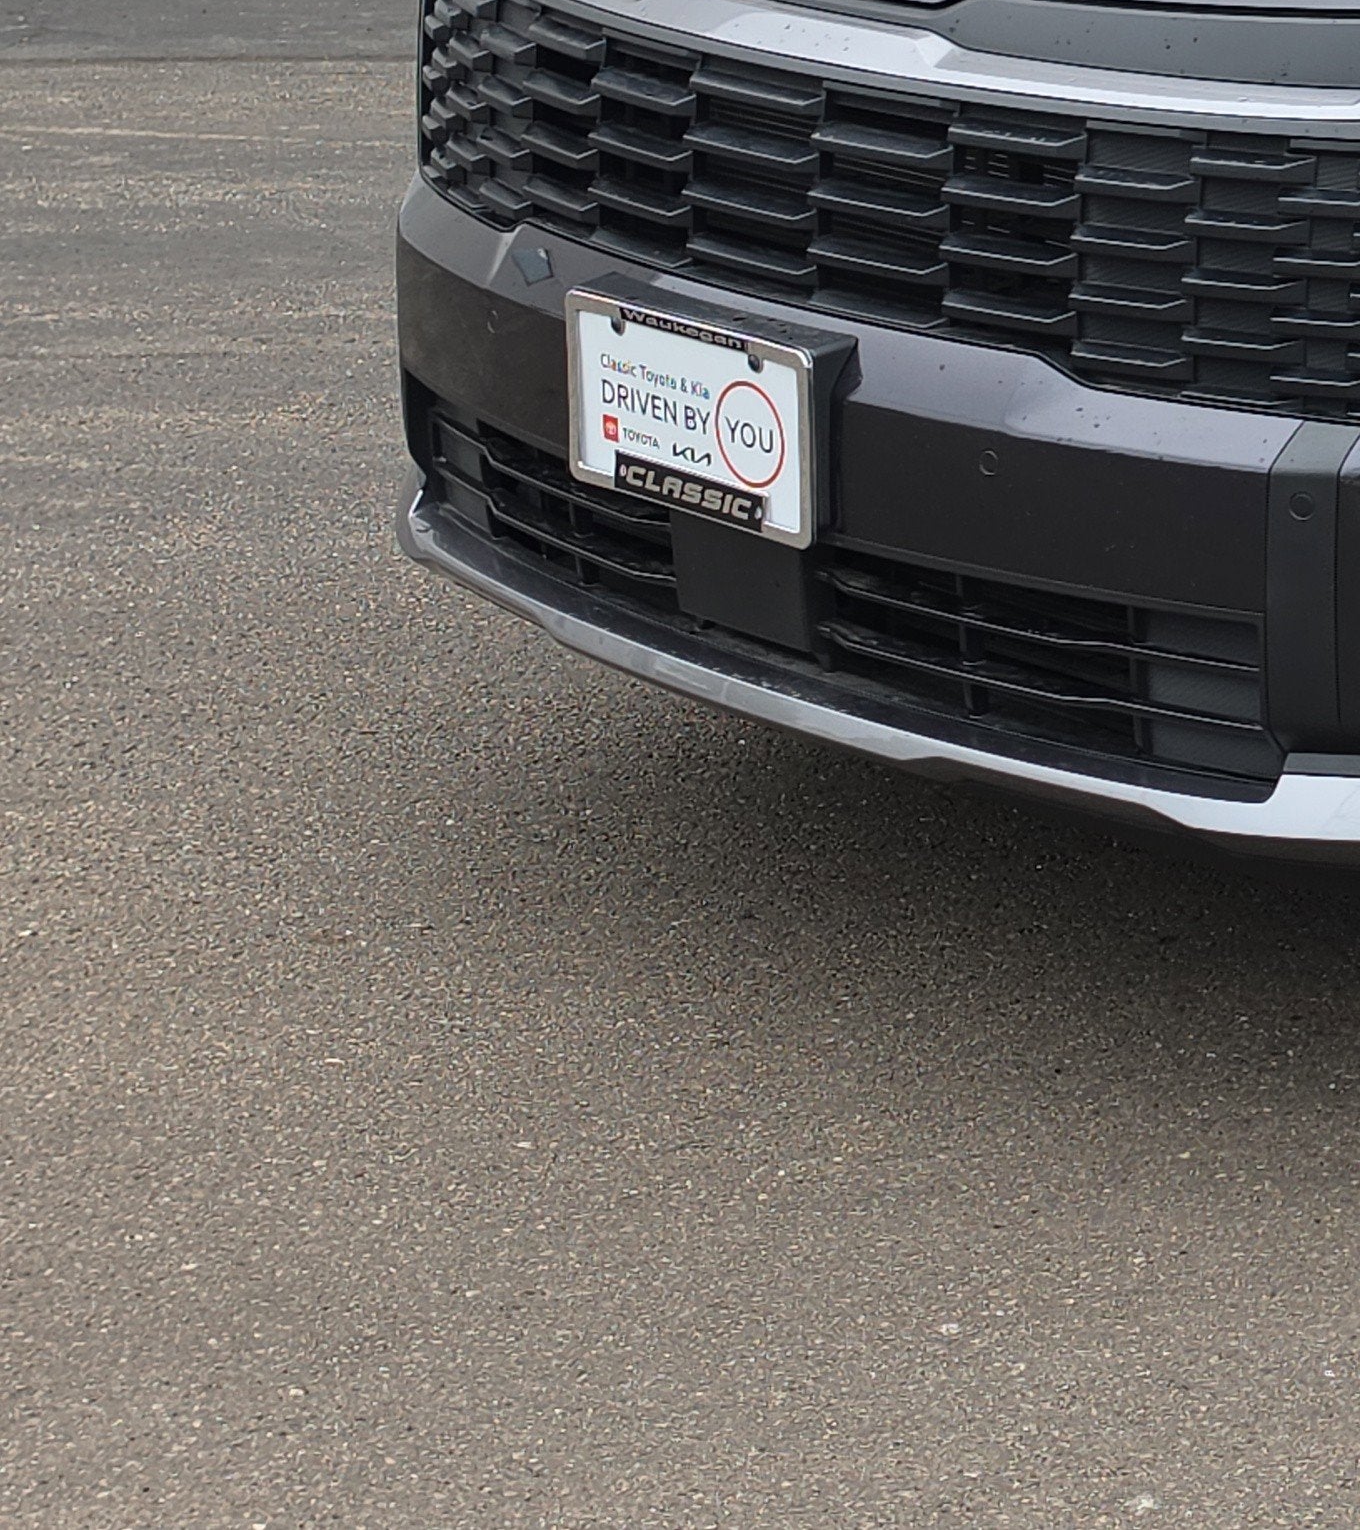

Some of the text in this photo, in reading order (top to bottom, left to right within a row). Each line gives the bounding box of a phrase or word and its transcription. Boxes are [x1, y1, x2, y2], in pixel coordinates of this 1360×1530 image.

[622, 307, 743, 350] Waukegan
[600, 353, 637, 378] Classic
[639, 364, 678, 390] Toyota
[680, 377, 688, 393] &
[601, 378, 775, 455] DRIVEN BY YOU
[622, 426, 713, 467] TOYOTA KIA
[624, 464, 753, 521] CLASSIC
